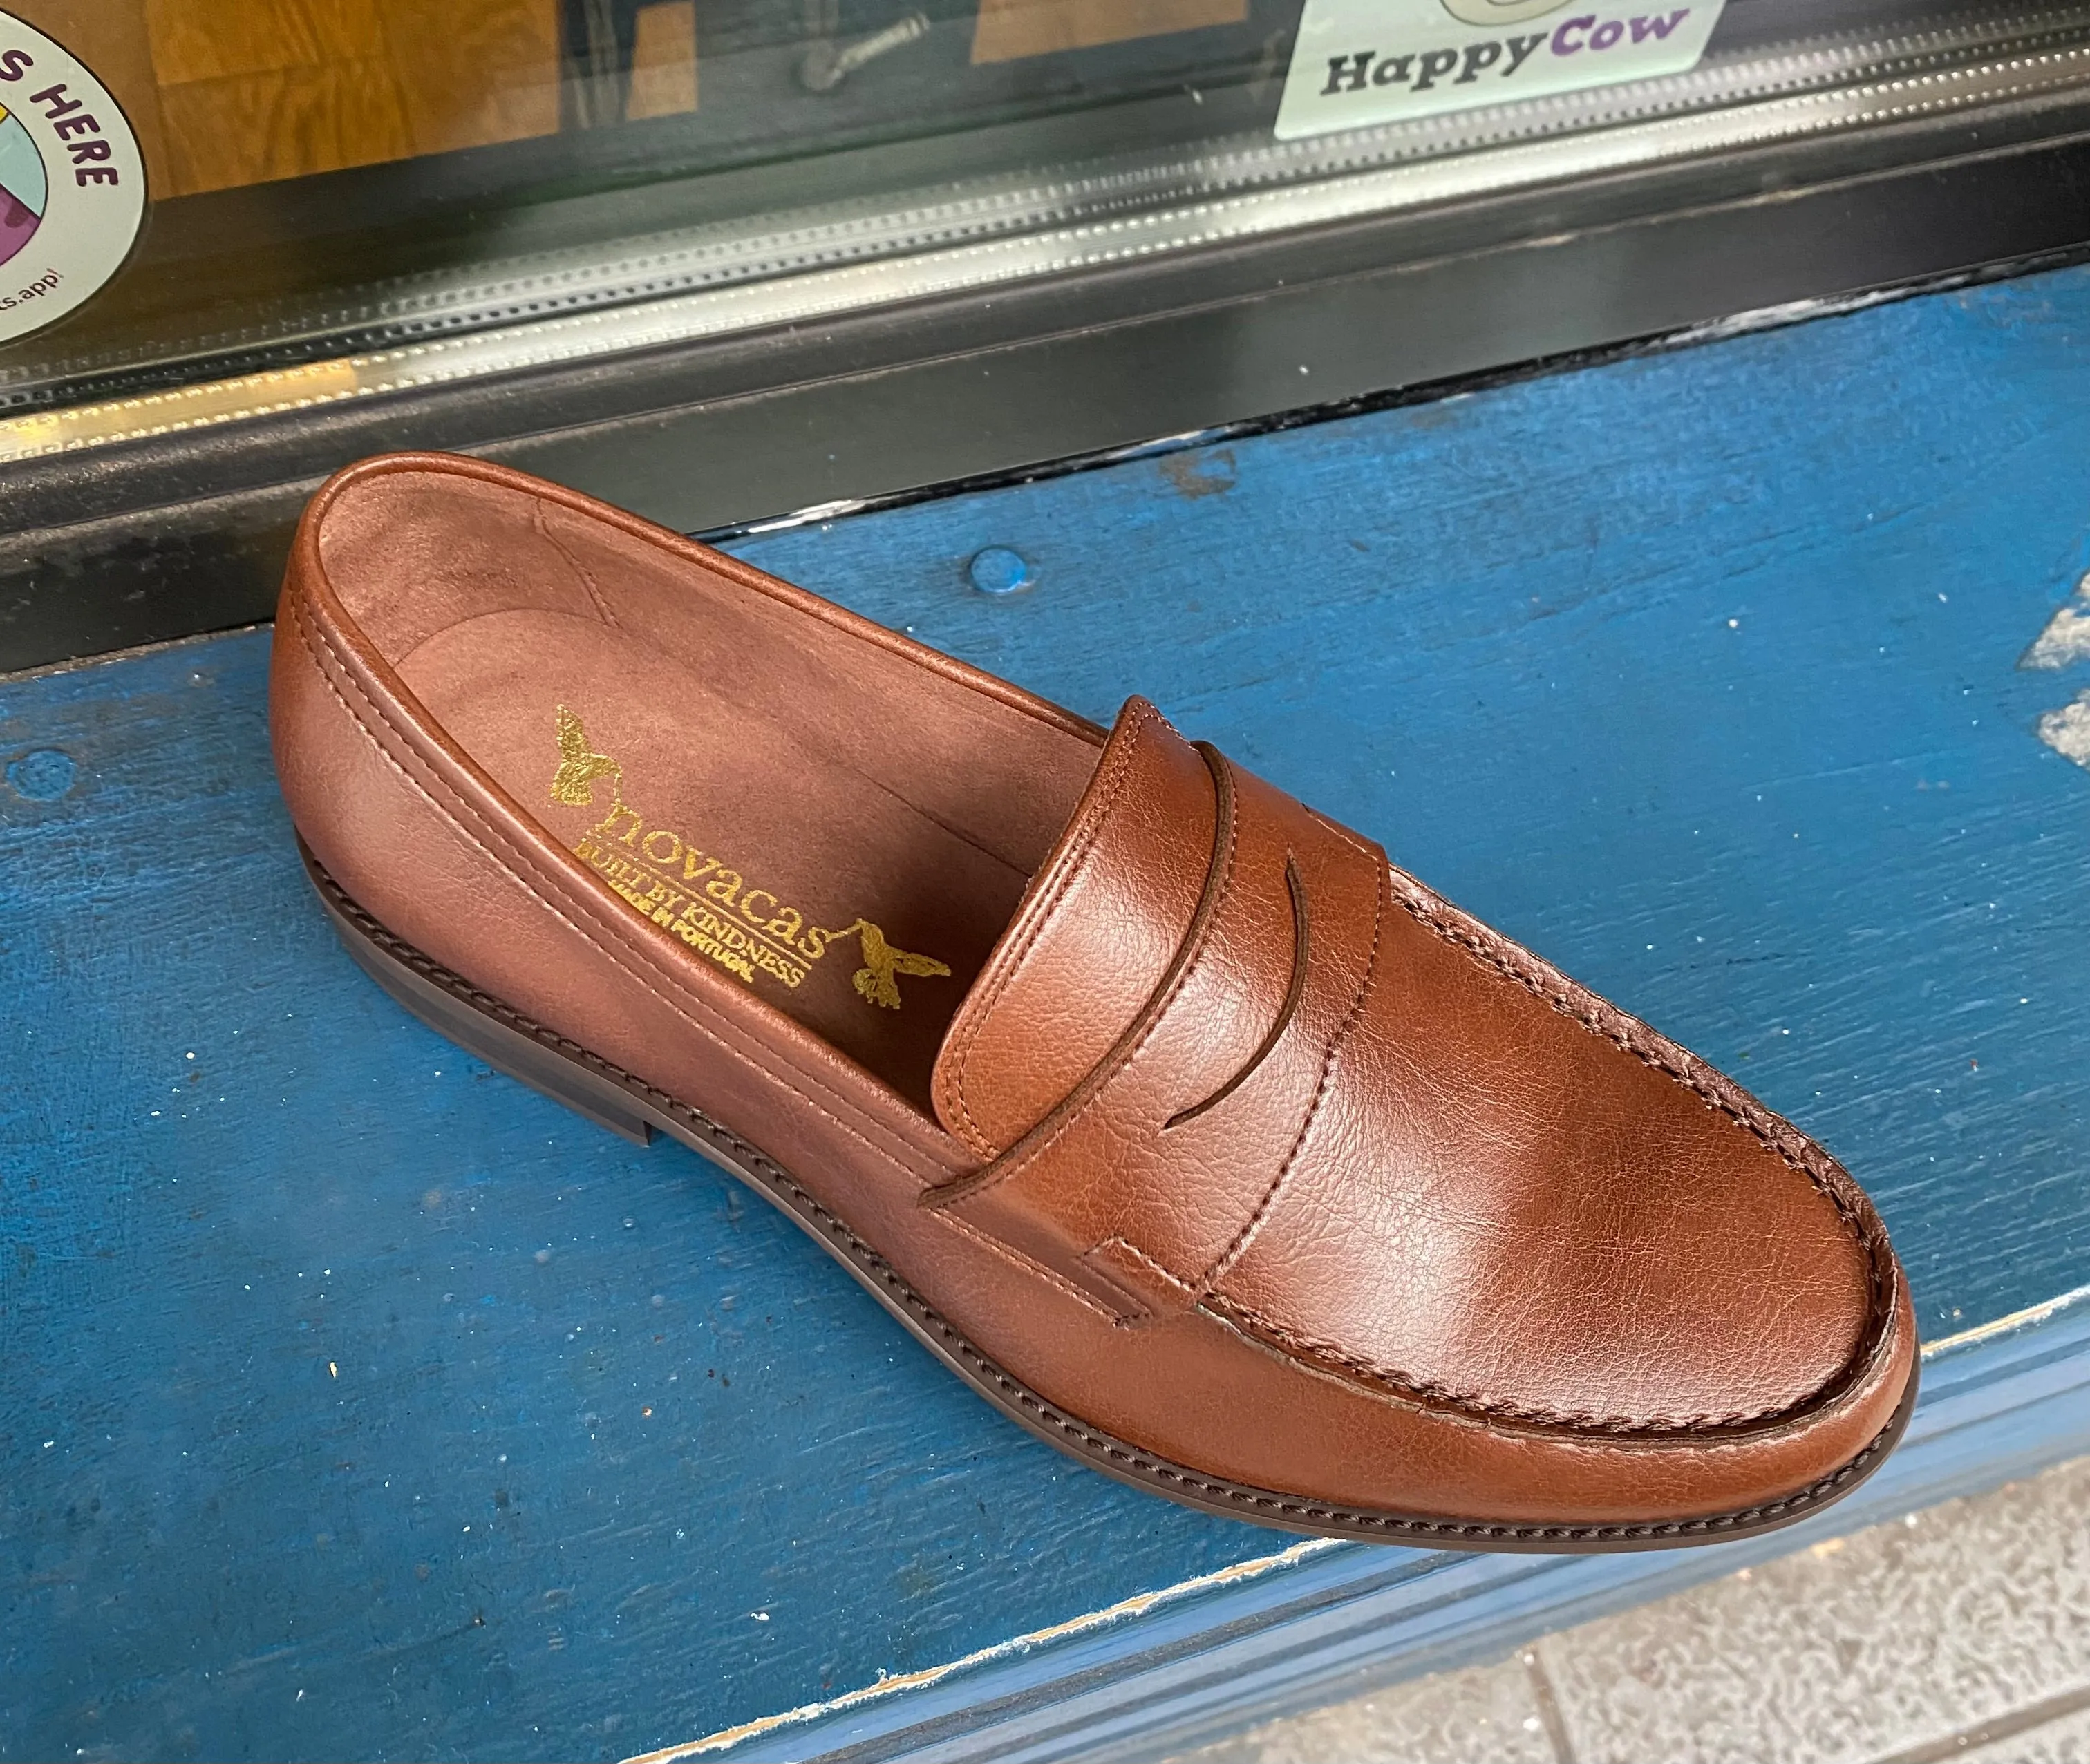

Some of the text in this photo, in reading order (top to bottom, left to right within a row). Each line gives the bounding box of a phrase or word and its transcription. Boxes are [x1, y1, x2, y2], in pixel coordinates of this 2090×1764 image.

[1320, 9, 1691, 96] HappyCow
[29, 83, 120, 187] HERE
[573, 841, 805, 988] BUILT BY KINDNESS
[594, 802, 831, 959] novacas
[670, 918, 754, 983] PORTUGAL
